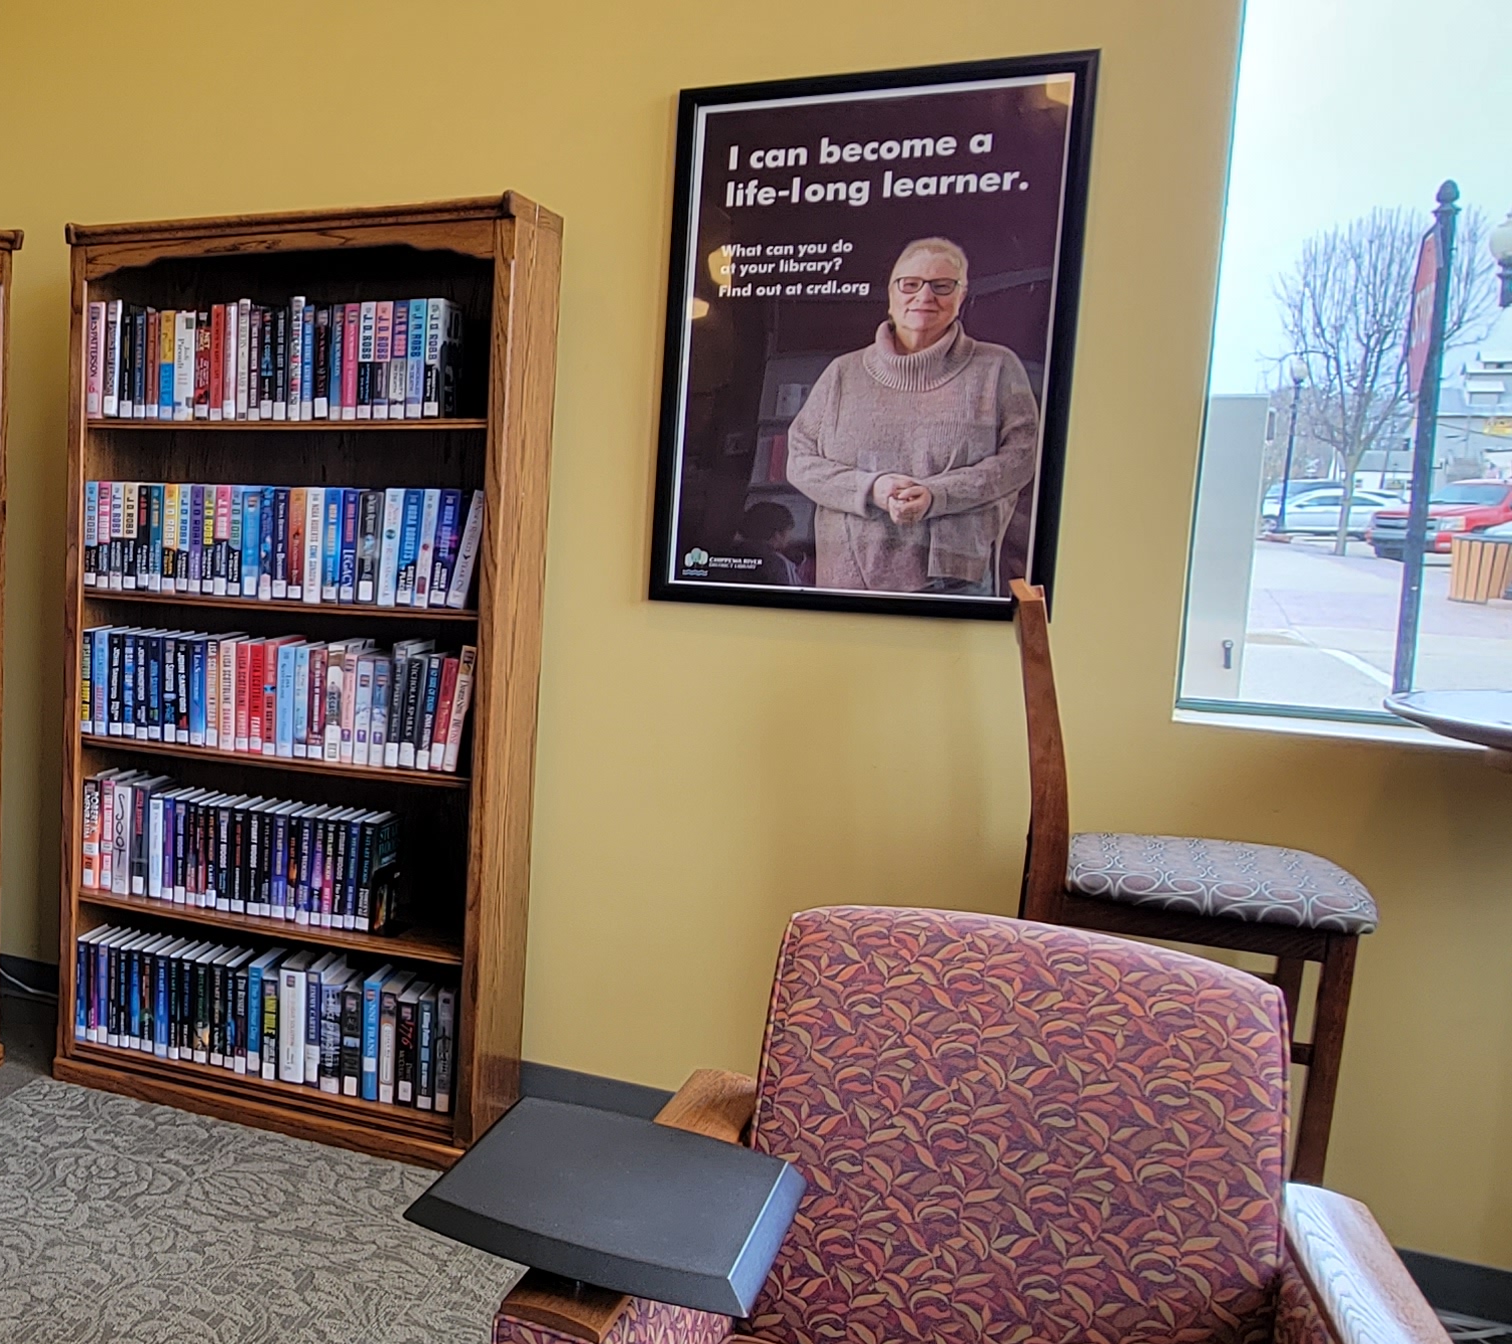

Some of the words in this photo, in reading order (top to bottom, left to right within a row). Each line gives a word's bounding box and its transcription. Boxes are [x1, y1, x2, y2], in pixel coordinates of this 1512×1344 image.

[728, 145, 738, 171] I
[749, 147, 808, 170] can
[819, 135, 957, 164] become
[969, 133, 993, 154] a
[725, 173, 870, 207] life-long
[882, 170, 1029, 198] learner.
[720, 244, 763, 257] What
[766, 244, 794, 256] can
[798, 243, 828, 258] you
[831, 239, 854, 254] do
[720, 263, 736, 275] at
[739, 263, 776, 278] your
[779, 257, 843, 275] library?
[718, 283, 752, 297] Find
[756, 284, 782, 297] out
[785, 283, 802, 296] at
[806, 280, 870, 296] crdl.org
[361, 335, 373, 360] ROBB
[377, 336, 389, 360] ROBB
[410, 334, 422, 358] ROBB
[342, 549, 356, 588] LEGACY
[408, 662, 420, 704] NICHOLAS
[405, 706, 416, 737] SPARKS
[249, 1026, 258, 1041] Day
[367, 1026, 377, 1057] FRANK
